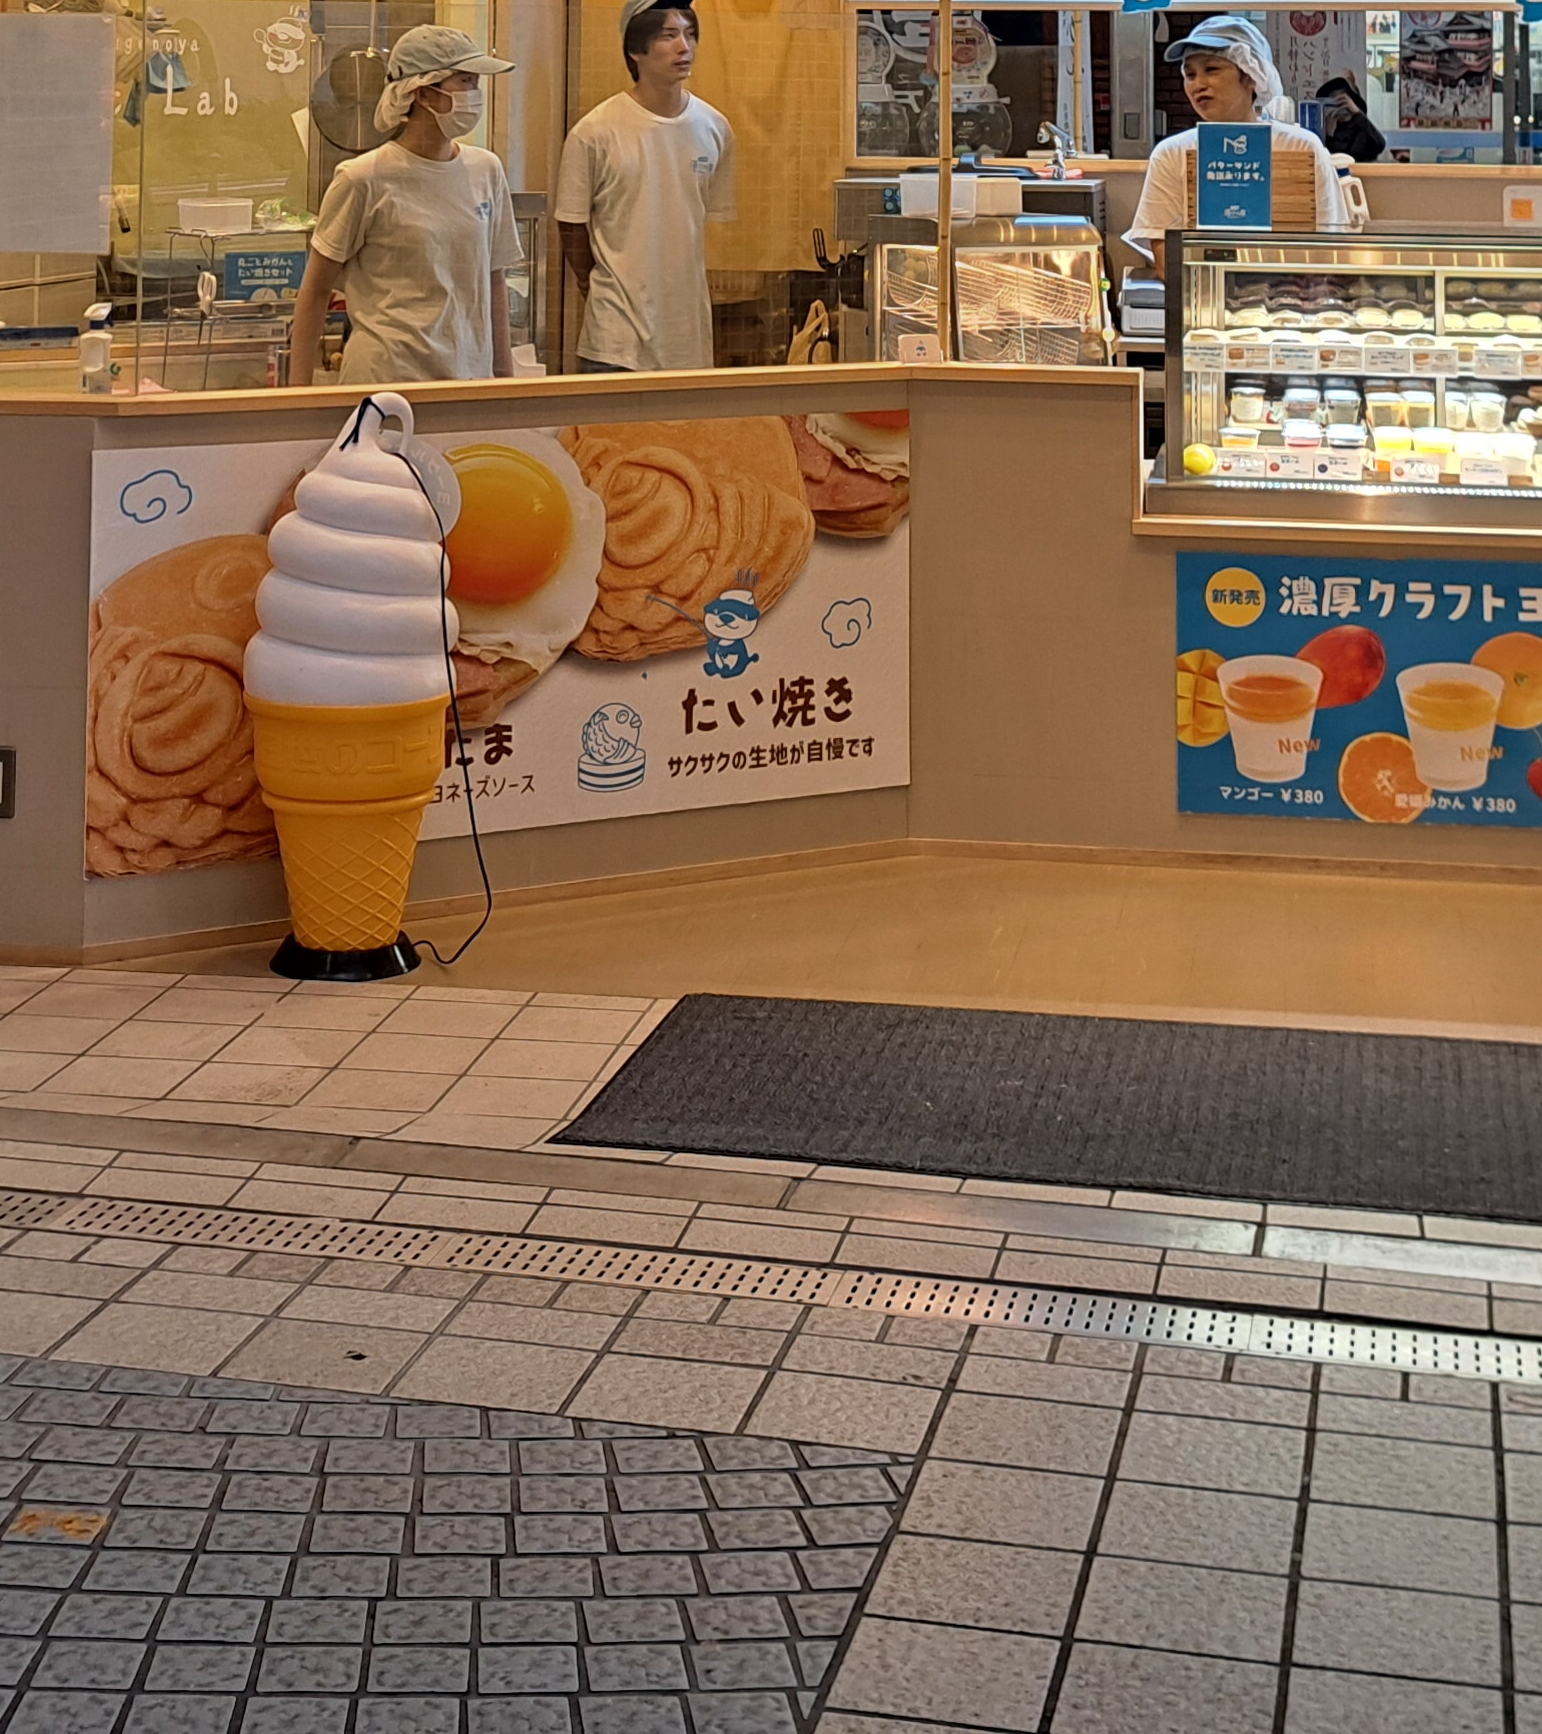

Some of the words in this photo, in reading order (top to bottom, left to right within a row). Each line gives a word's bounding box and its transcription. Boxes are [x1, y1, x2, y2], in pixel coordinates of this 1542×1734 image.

[163, 62, 239, 116] Lab
[1212, 589, 1261, 606] 新発売
[681, 675, 854, 736] たい焼き
[1278, 737, 1321, 754] New
[1460, 745, 1505, 762] New
[667, 736, 876, 778] サクサクの生地が自慢です
[1219, 786, 1274, 801] マンゴー
[1280, 788, 1324, 804] ¥380
[1472, 796, 1517, 814] ¥380
